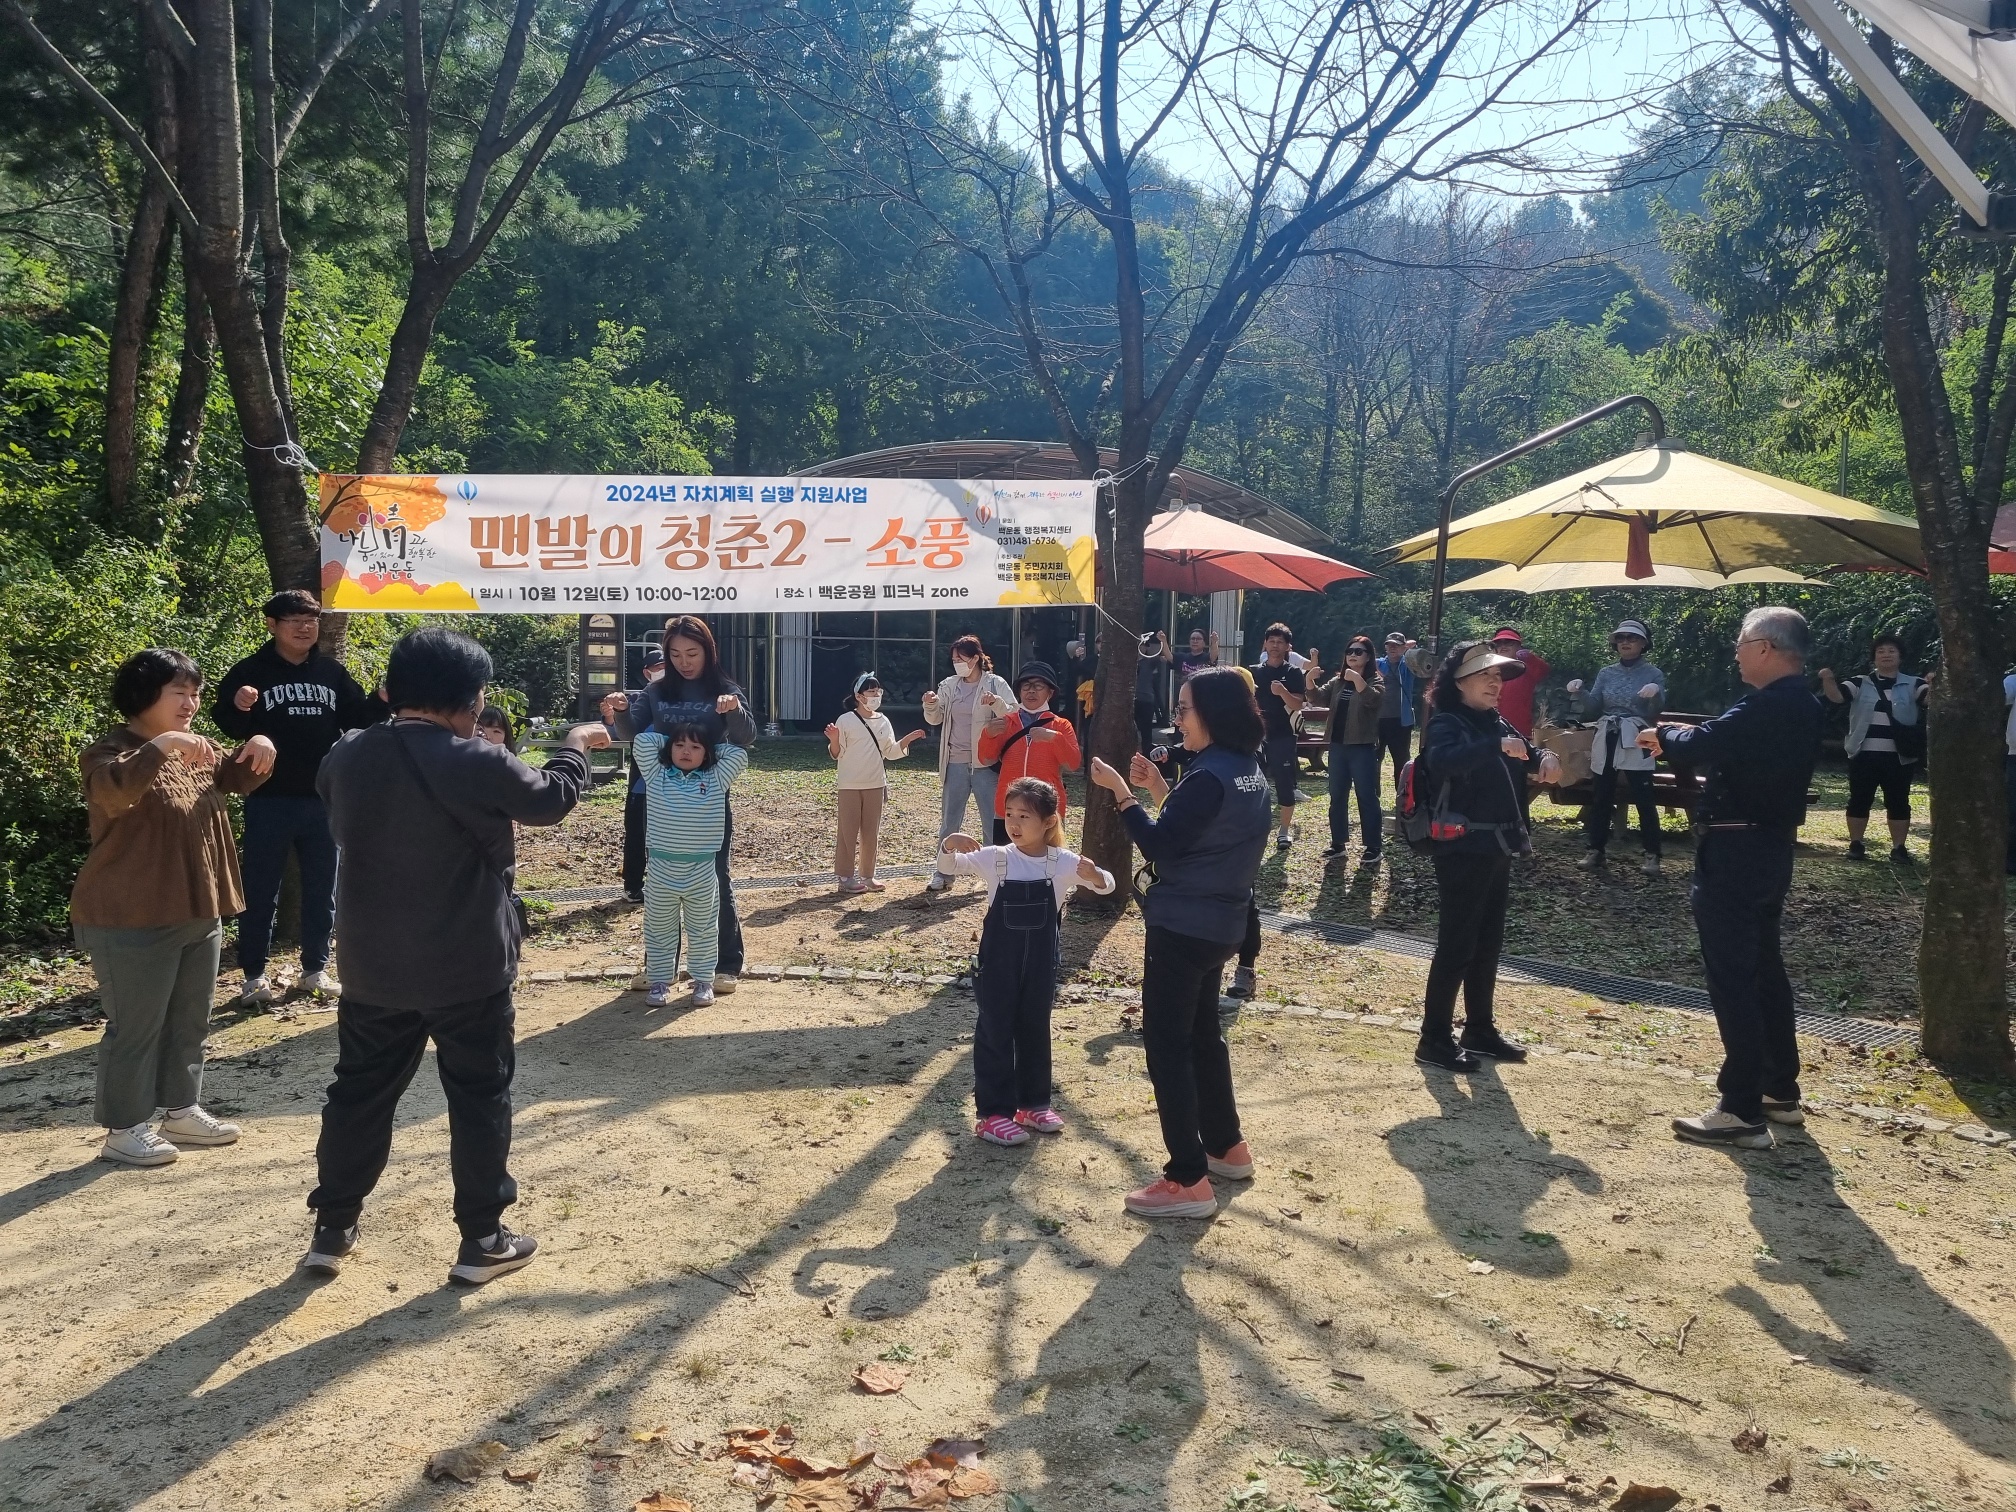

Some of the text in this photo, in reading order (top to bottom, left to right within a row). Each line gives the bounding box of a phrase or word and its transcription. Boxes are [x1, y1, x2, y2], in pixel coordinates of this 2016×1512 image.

[606, 485, 868, 503] 2024년 자치계획 실행 지원사업
[998, 526, 1072, 535] 백운동 행정복지센터
[468, 513, 643, 570] 맨발의
[656, 513, 807, 571] 청춘2
[866, 517, 970, 569] 소풍
[997, 536, 1057, 546] 031)481-6736
[368, 560, 416, 580] 백운동
[997, 562, 1063, 571] 백운동 주민자치회
[997, 572, 1071, 582] 백운동 행정복지센터
[479, 586, 738, 602] 일시 10월 12일(토) 10:00~12:00
[783, 584, 969, 600] 장소 백운공원 피크닉 zone
